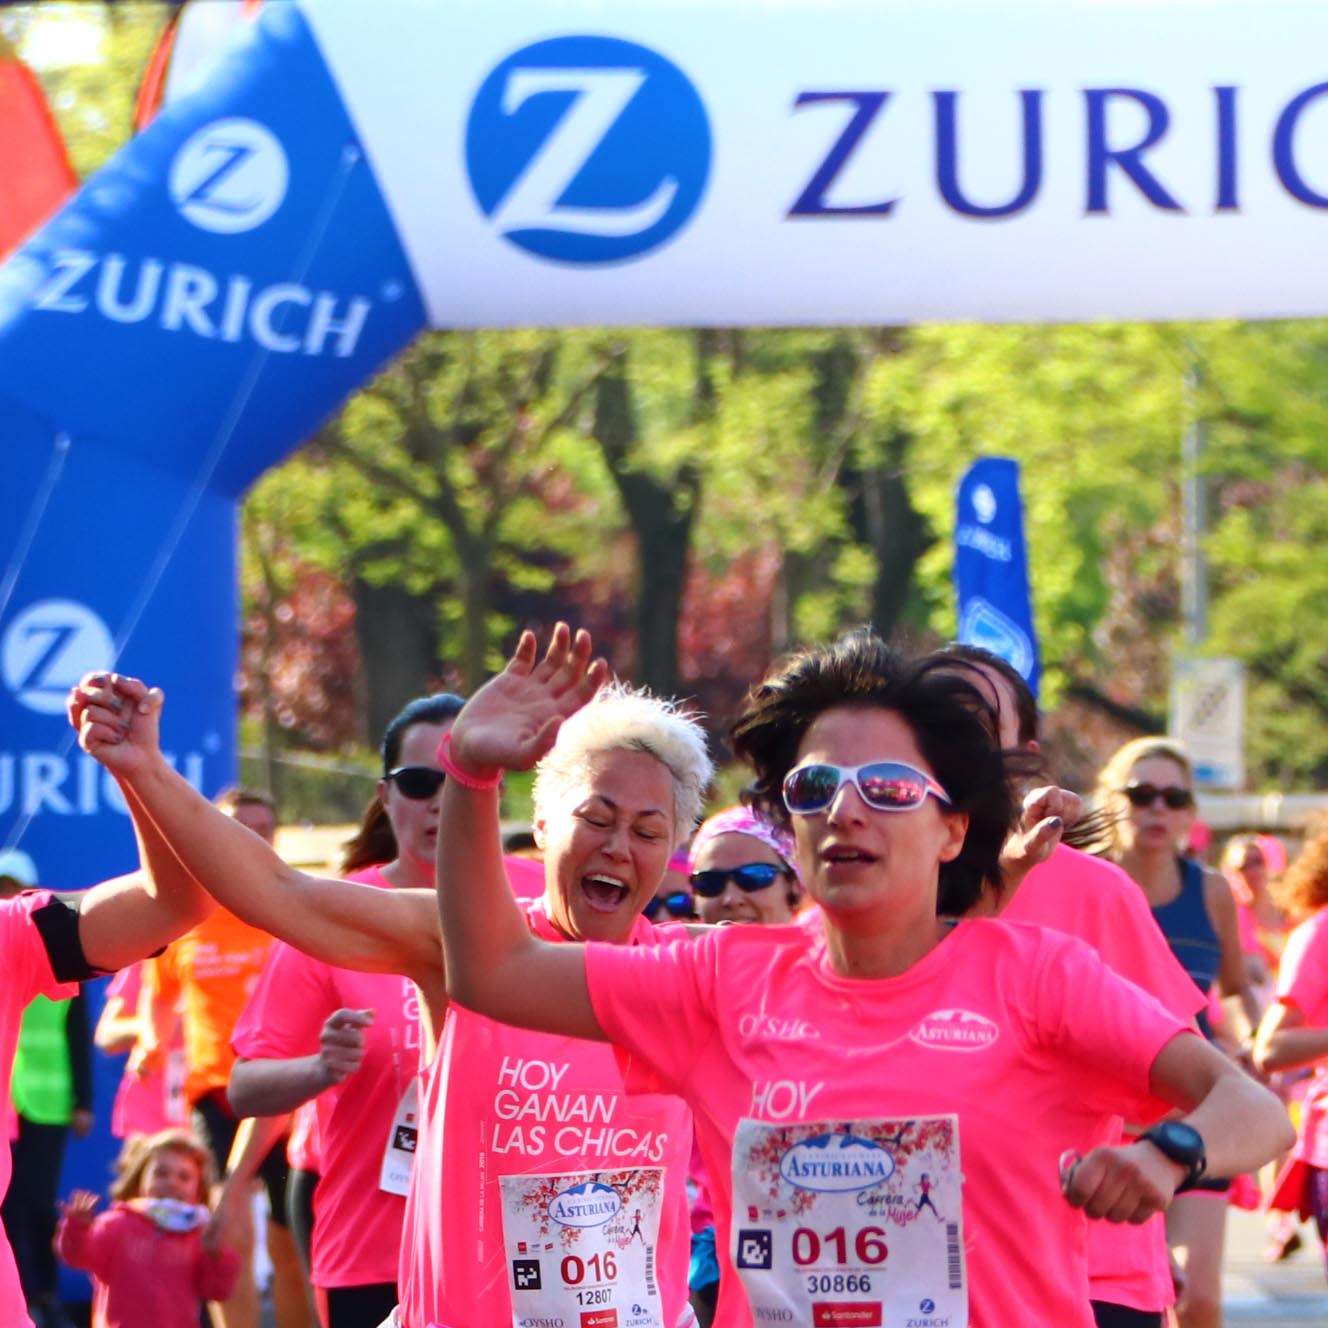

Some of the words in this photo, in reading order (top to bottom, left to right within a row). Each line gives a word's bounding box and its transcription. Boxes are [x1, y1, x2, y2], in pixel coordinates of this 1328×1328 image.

[35, 252, 371, 359] ZURICH
[918, 1023, 992, 1042] ASTURIANA
[497, 1055, 571, 1091] HOY
[494, 1089, 618, 1124] GANAN
[748, 1079, 825, 1120] HOY
[491, 1123, 547, 1156] LAS
[553, 1126, 669, 1163] CHICAS
[786, 1156, 886, 1178] ASTURIANA
[555, 1201, 616, 1219] ASTURIANA
[856, 1191, 904, 1206] Carrera
[791, 1225, 889, 1266] 016
[560, 1250, 618, 1286] 016
[576, 1288, 612, 1306] 12807
[807, 1274, 872, 1294] 30866
[906, 1319, 948, 1328] ZURICH
